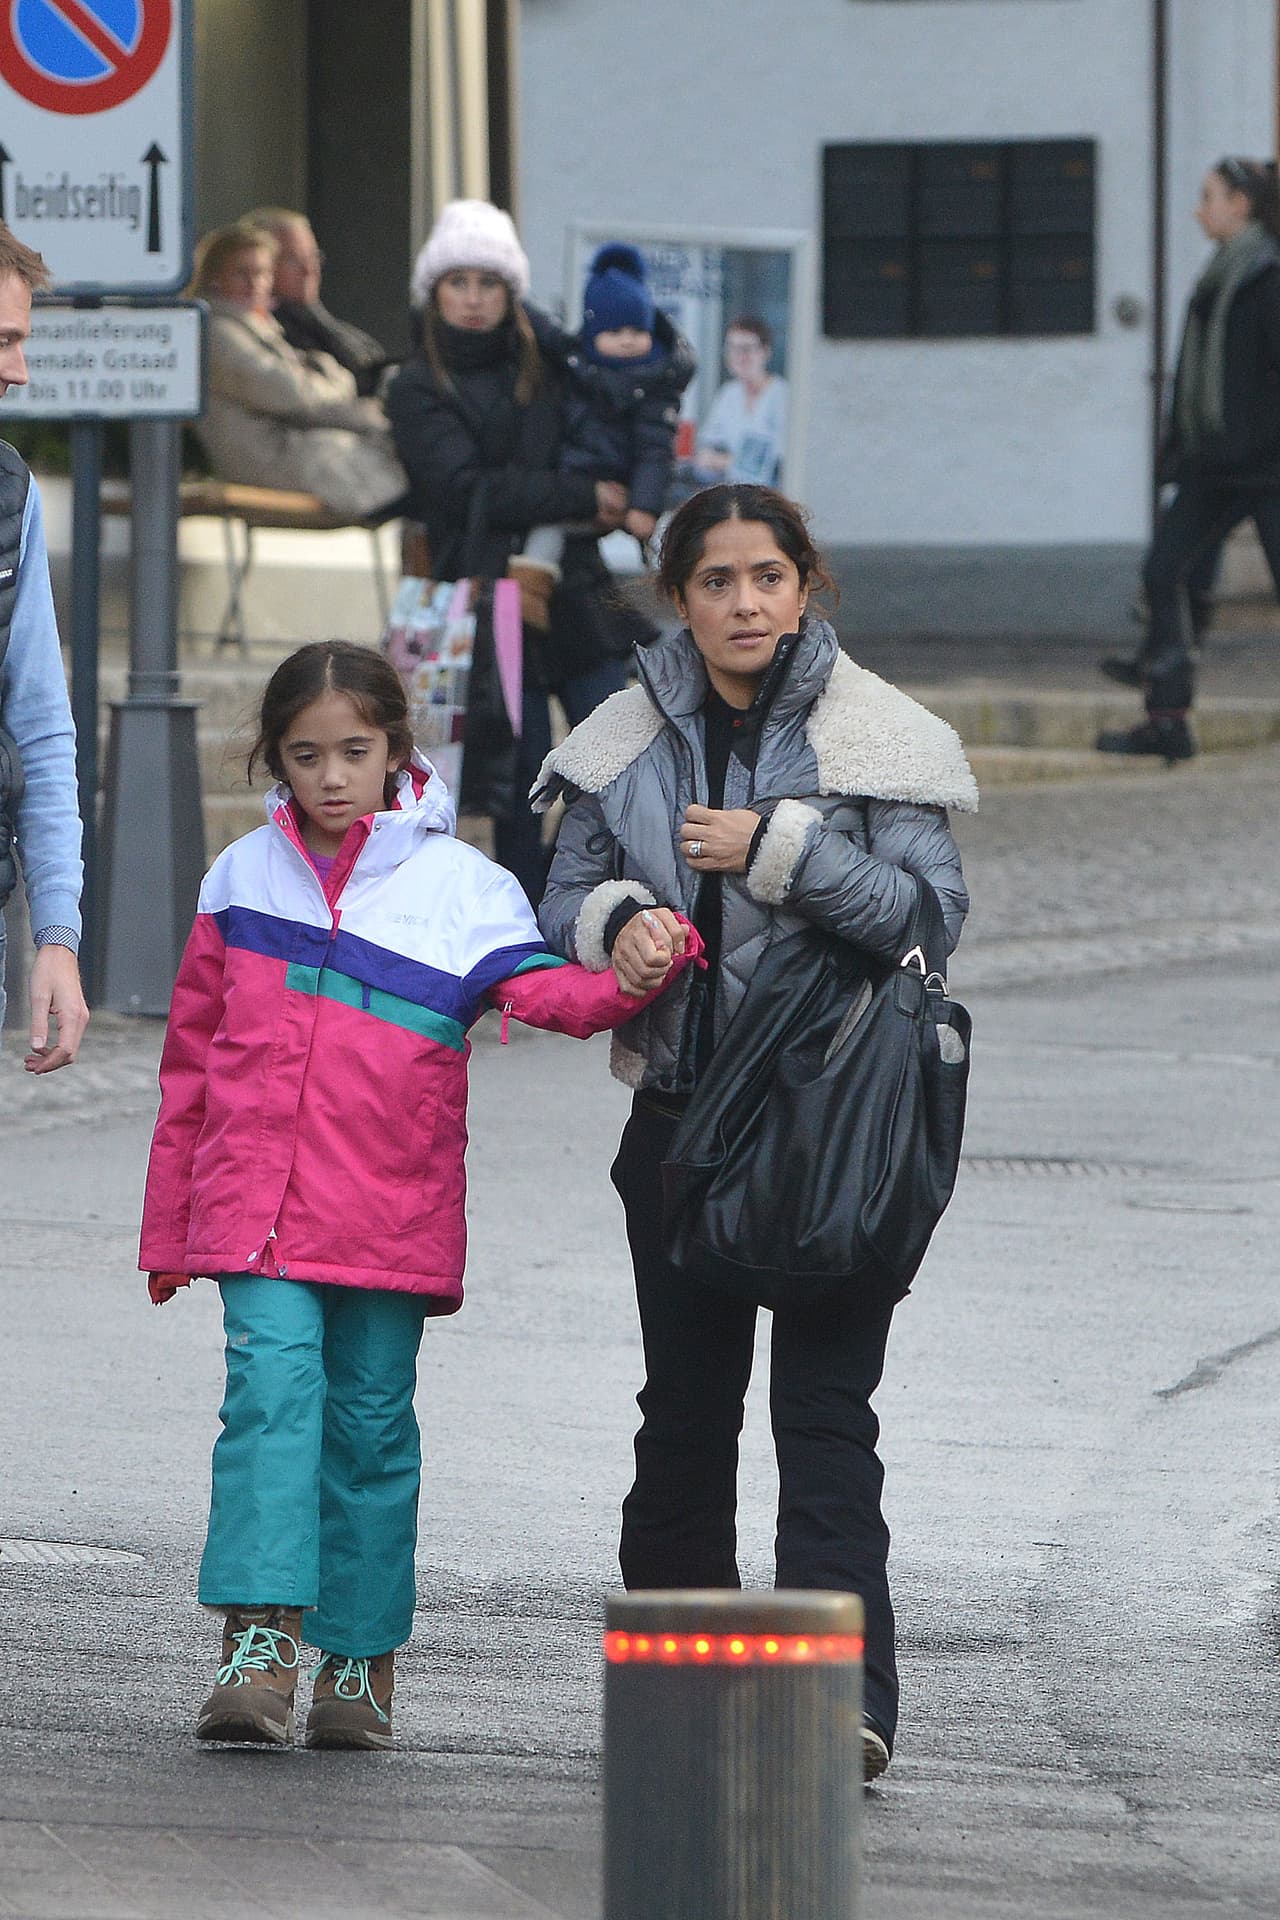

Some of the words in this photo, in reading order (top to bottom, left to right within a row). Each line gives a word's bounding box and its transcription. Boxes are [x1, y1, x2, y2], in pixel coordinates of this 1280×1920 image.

[15, 171, 140, 229] beidseitig
[103, 347, 178, 371] Gstaad
[29, 379, 58, 400] bis
[130, 378, 167, 400] Uhr
